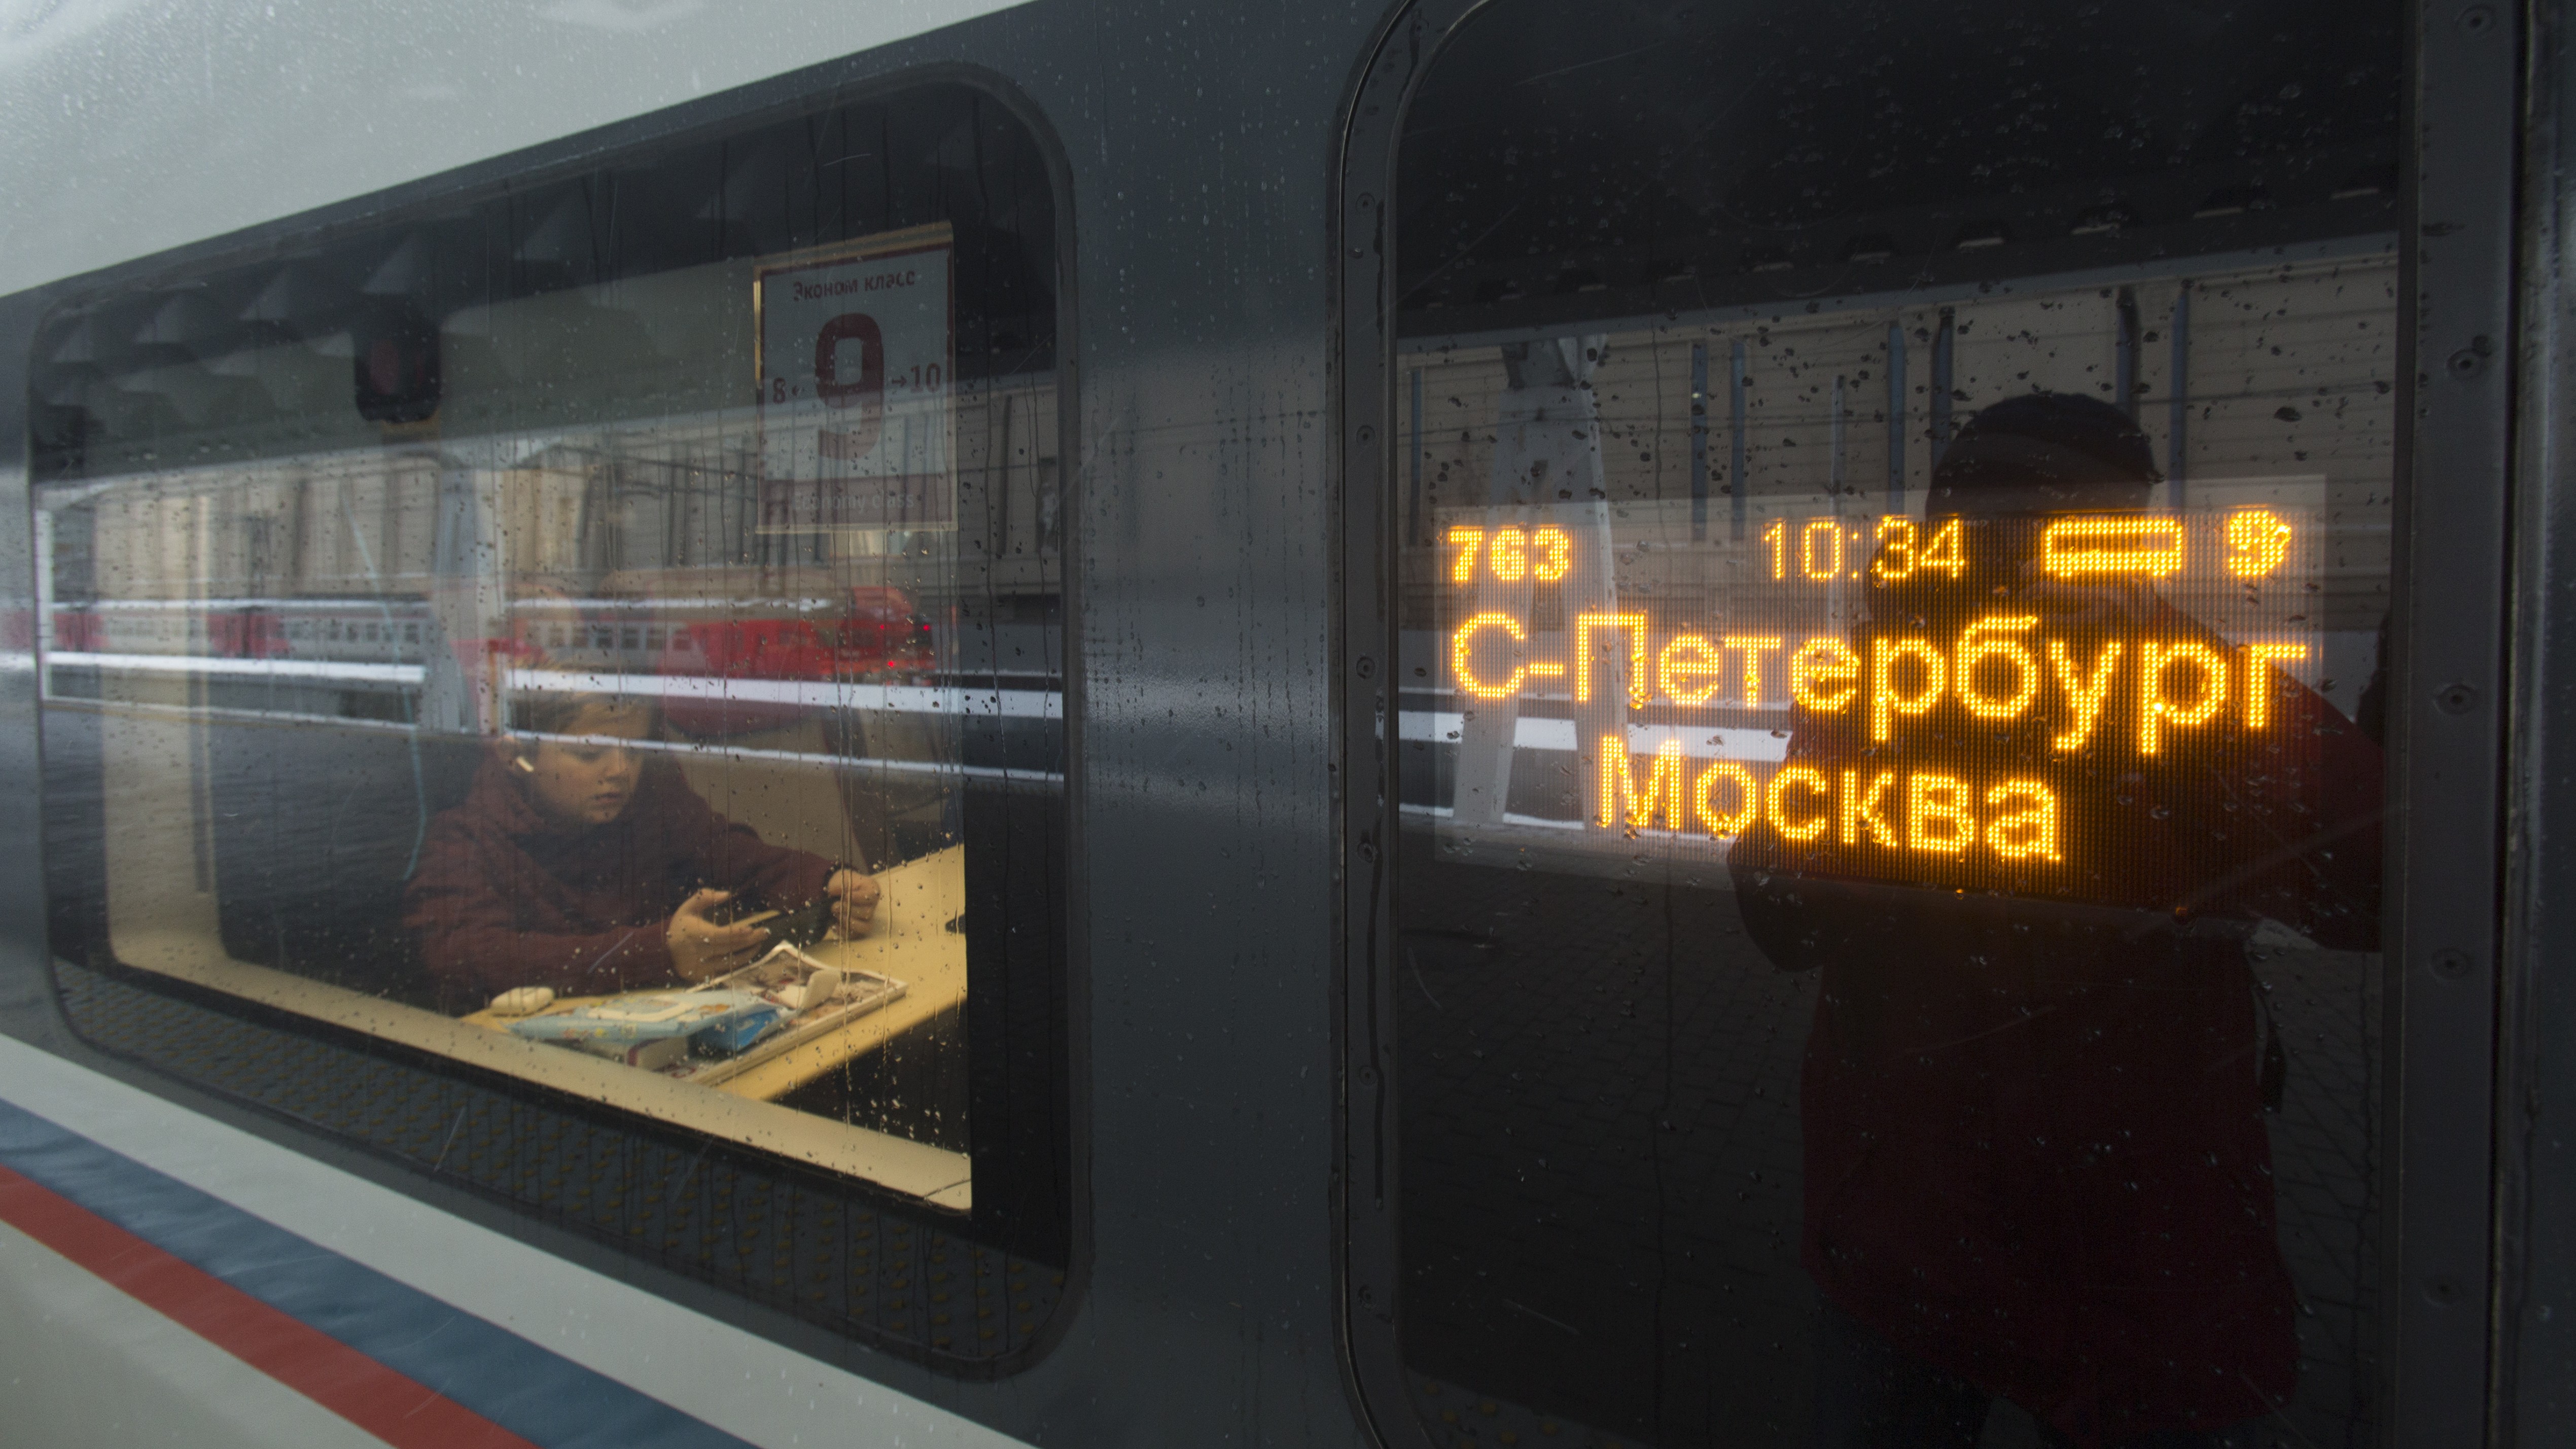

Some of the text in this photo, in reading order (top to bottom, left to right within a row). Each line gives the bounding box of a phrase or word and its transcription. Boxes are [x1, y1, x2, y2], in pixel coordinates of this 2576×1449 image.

[793, 270, 915, 301] Эконом класс
[773, 313, 941, 460] 8 9 10
[1449, 510, 2291, 581] 763 10:34 9
[1451, 611, 2313, 756] С-Петербург
[1595, 733, 2062, 862] Москва
